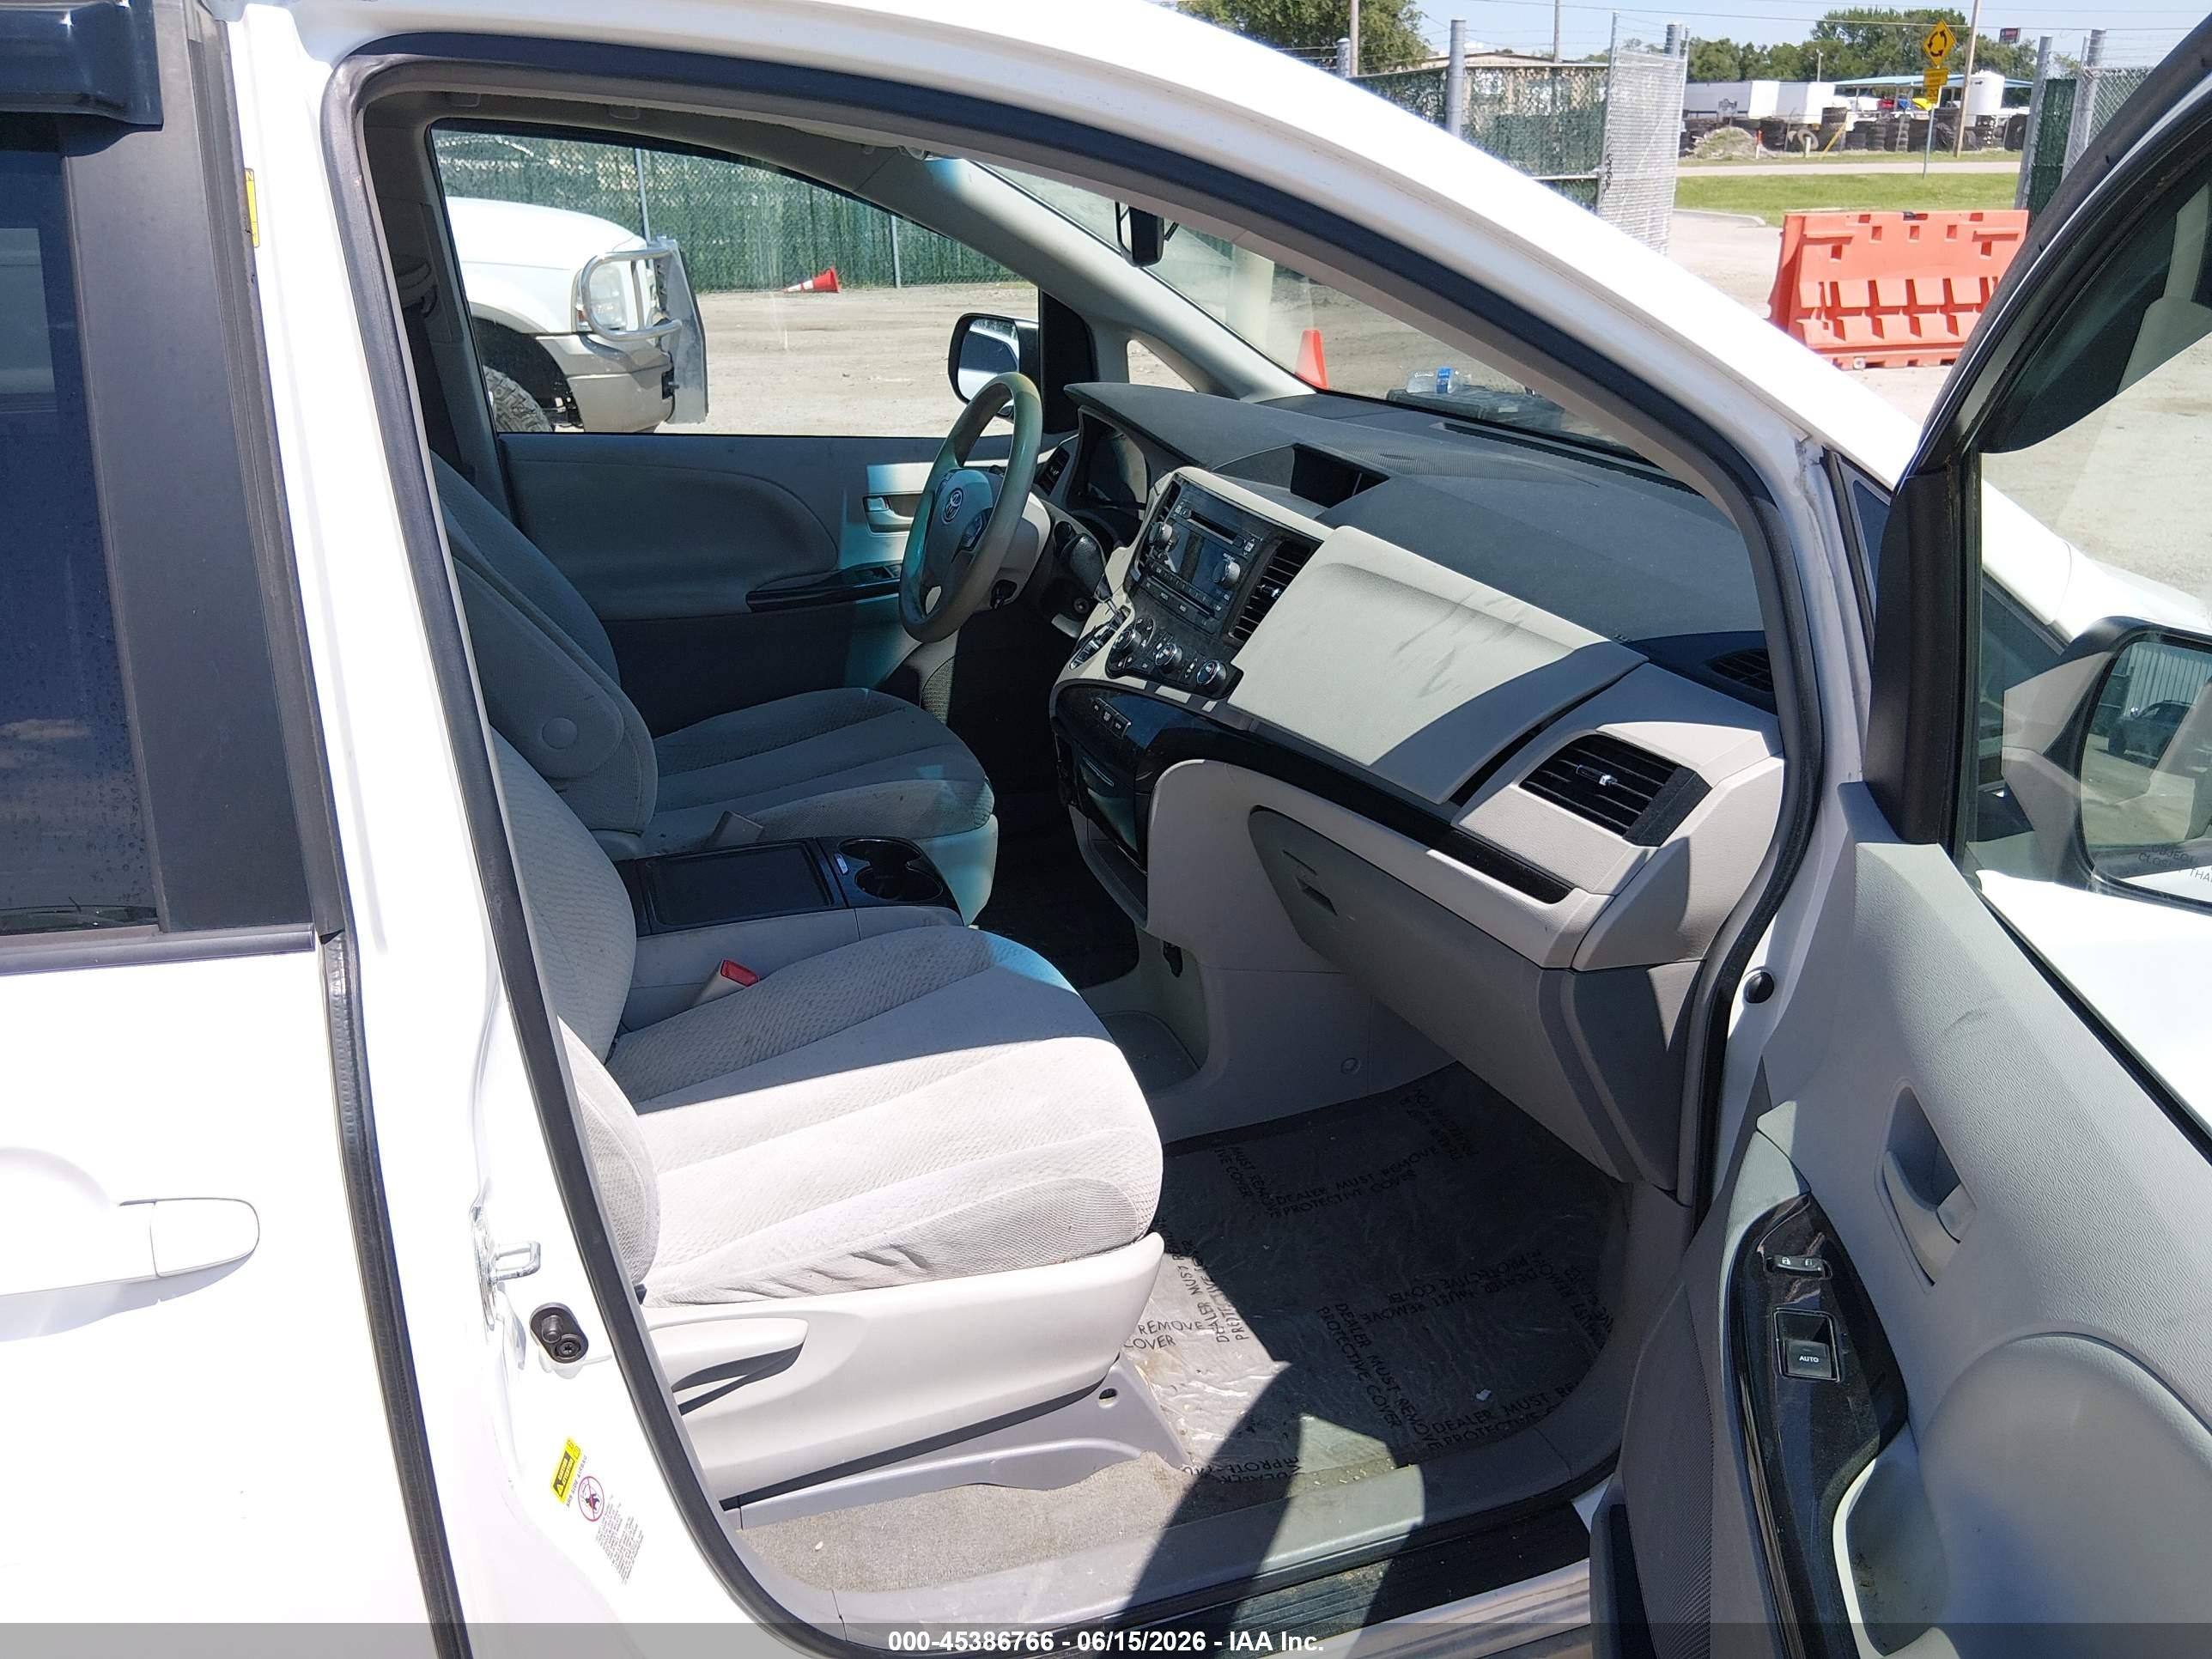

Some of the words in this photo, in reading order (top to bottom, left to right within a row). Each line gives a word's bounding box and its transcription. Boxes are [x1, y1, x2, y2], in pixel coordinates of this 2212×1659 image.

[2190, 867, 2212, 883] THA
[1335, 1173, 1375, 1190] MUST
[1178, 1265, 1203, 1296] MUST
[1138, 1320, 1204, 1335] REMOVE
[1197, 1301, 1231, 1343] DEALER
[1316, 1306, 1372, 1382] PROTECTIVE
[1366, 1383, 1403, 1429] COVER
[1334, 1302, 1372, 1349] DEALER
[1367, 1354, 1401, 1395] MUST
[1396, 1398, 1444, 1450] REMOVE
[1432, 1408, 1494, 1435] DEALER
[1504, 1392, 1550, 1416] MUST
